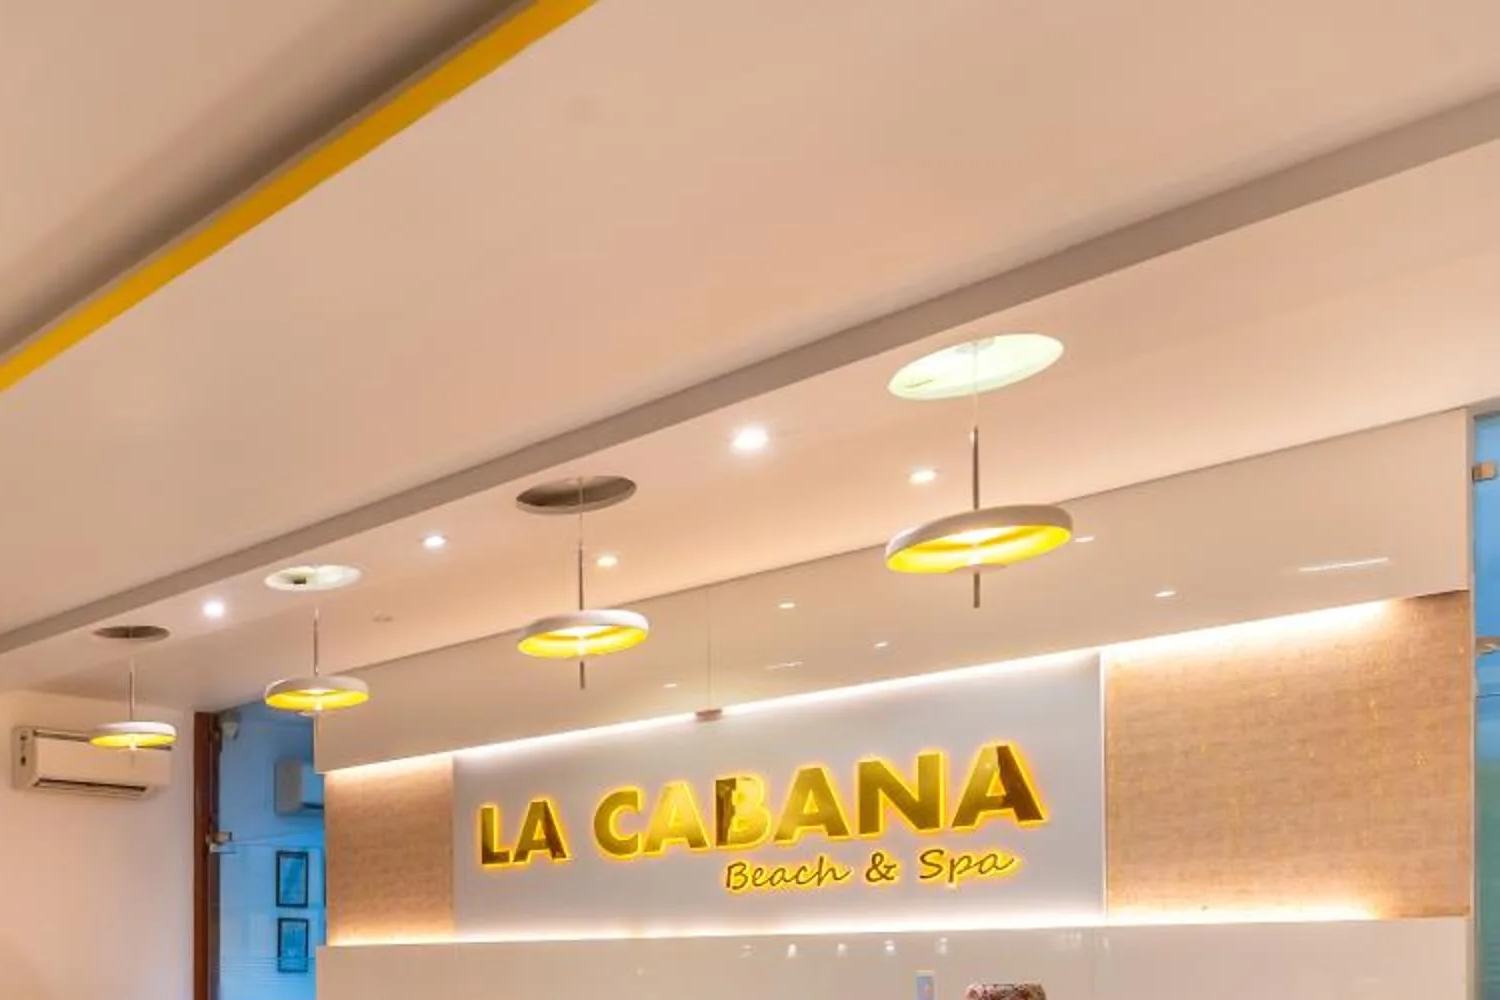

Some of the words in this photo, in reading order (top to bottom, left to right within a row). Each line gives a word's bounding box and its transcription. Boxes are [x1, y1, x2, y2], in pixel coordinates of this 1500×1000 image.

[479, 799, 567, 865] LA
[594, 743, 1046, 858] CABANA
[725, 859, 851, 891] Beach
[864, 856, 898, 882] &
[918, 848, 1015, 889] Spa
